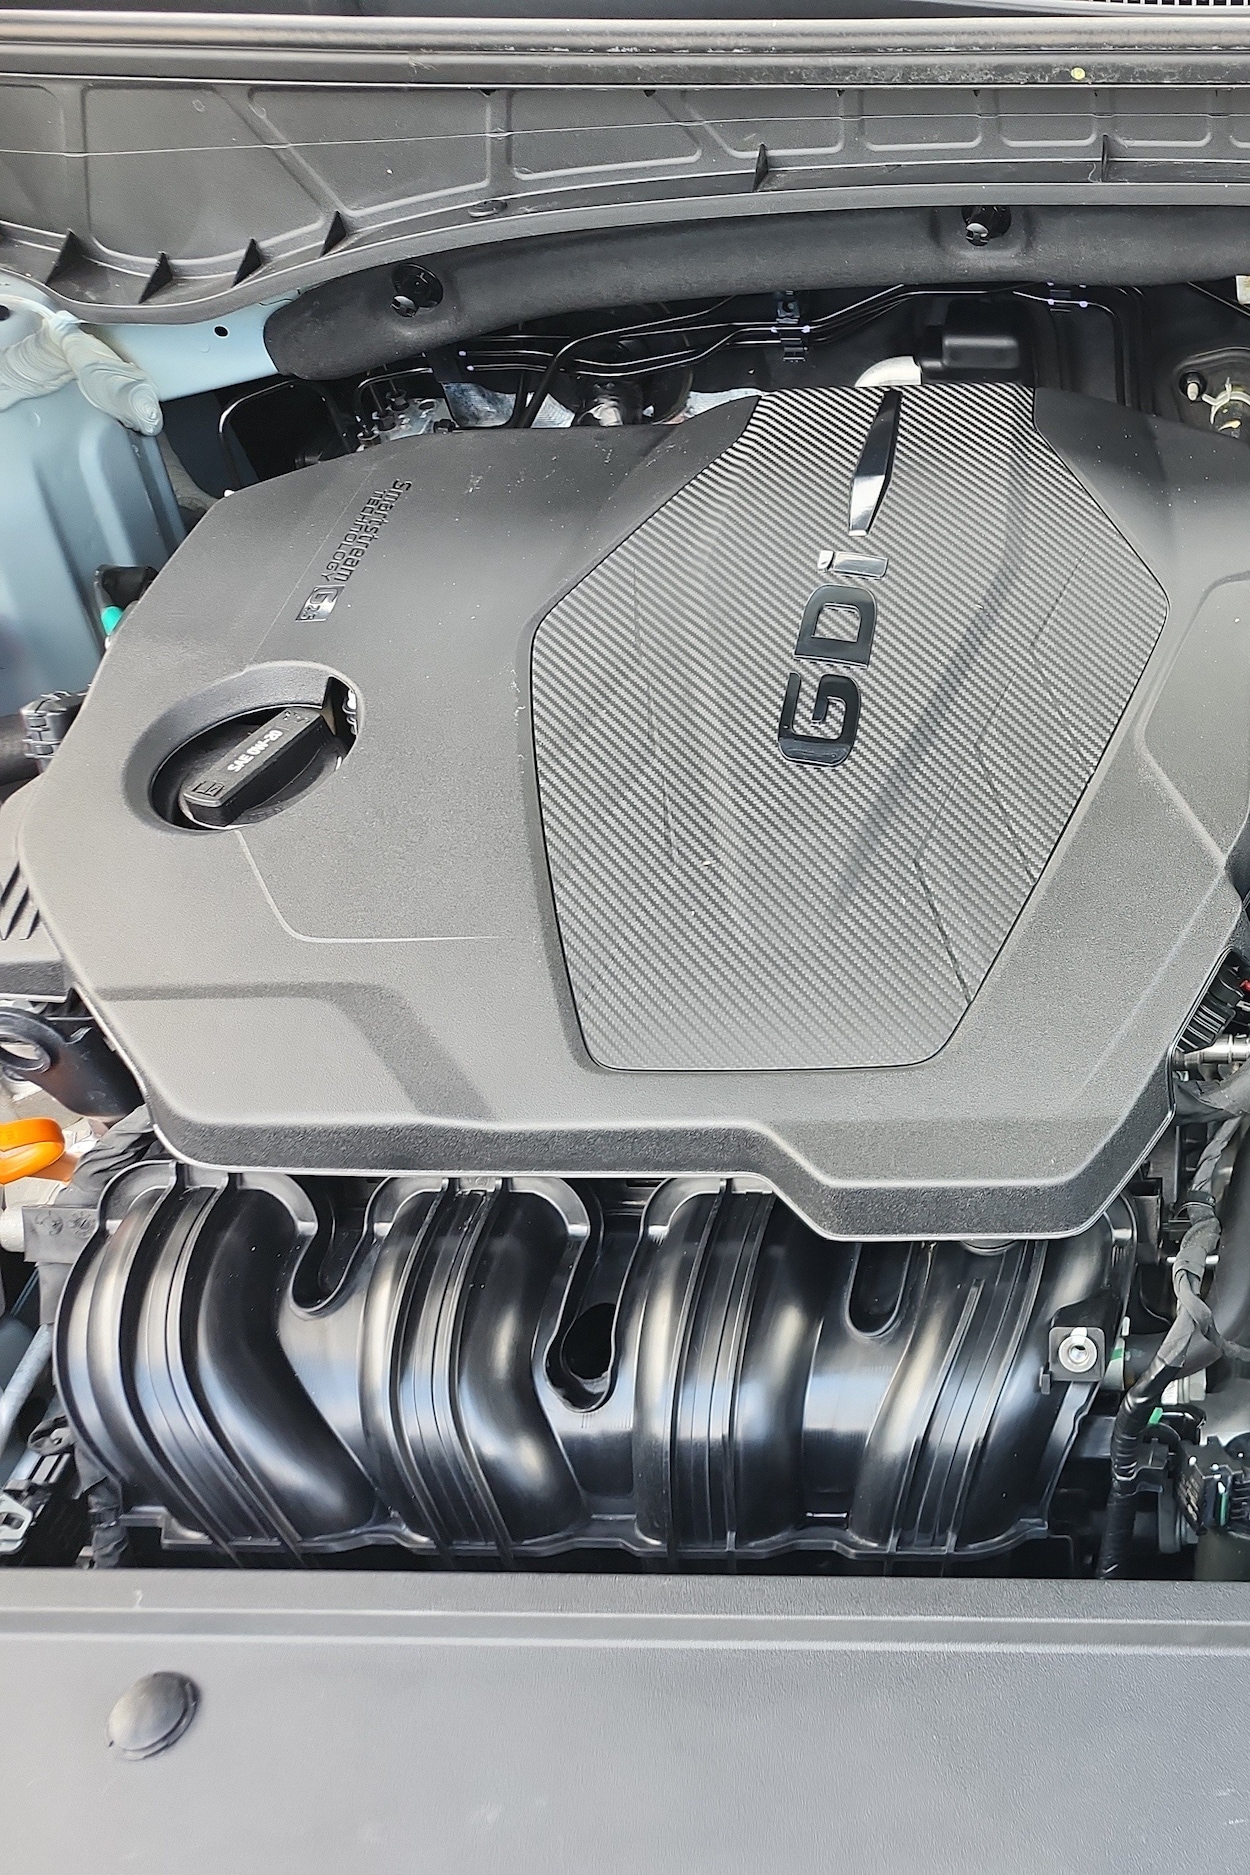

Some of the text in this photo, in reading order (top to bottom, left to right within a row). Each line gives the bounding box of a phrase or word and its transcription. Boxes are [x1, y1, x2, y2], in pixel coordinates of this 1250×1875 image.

[320, 489, 387, 582] TECHNOLOGY
[333, 478, 412, 583] Smartstream
[226, 729, 284, 773] SAE 0W-20
